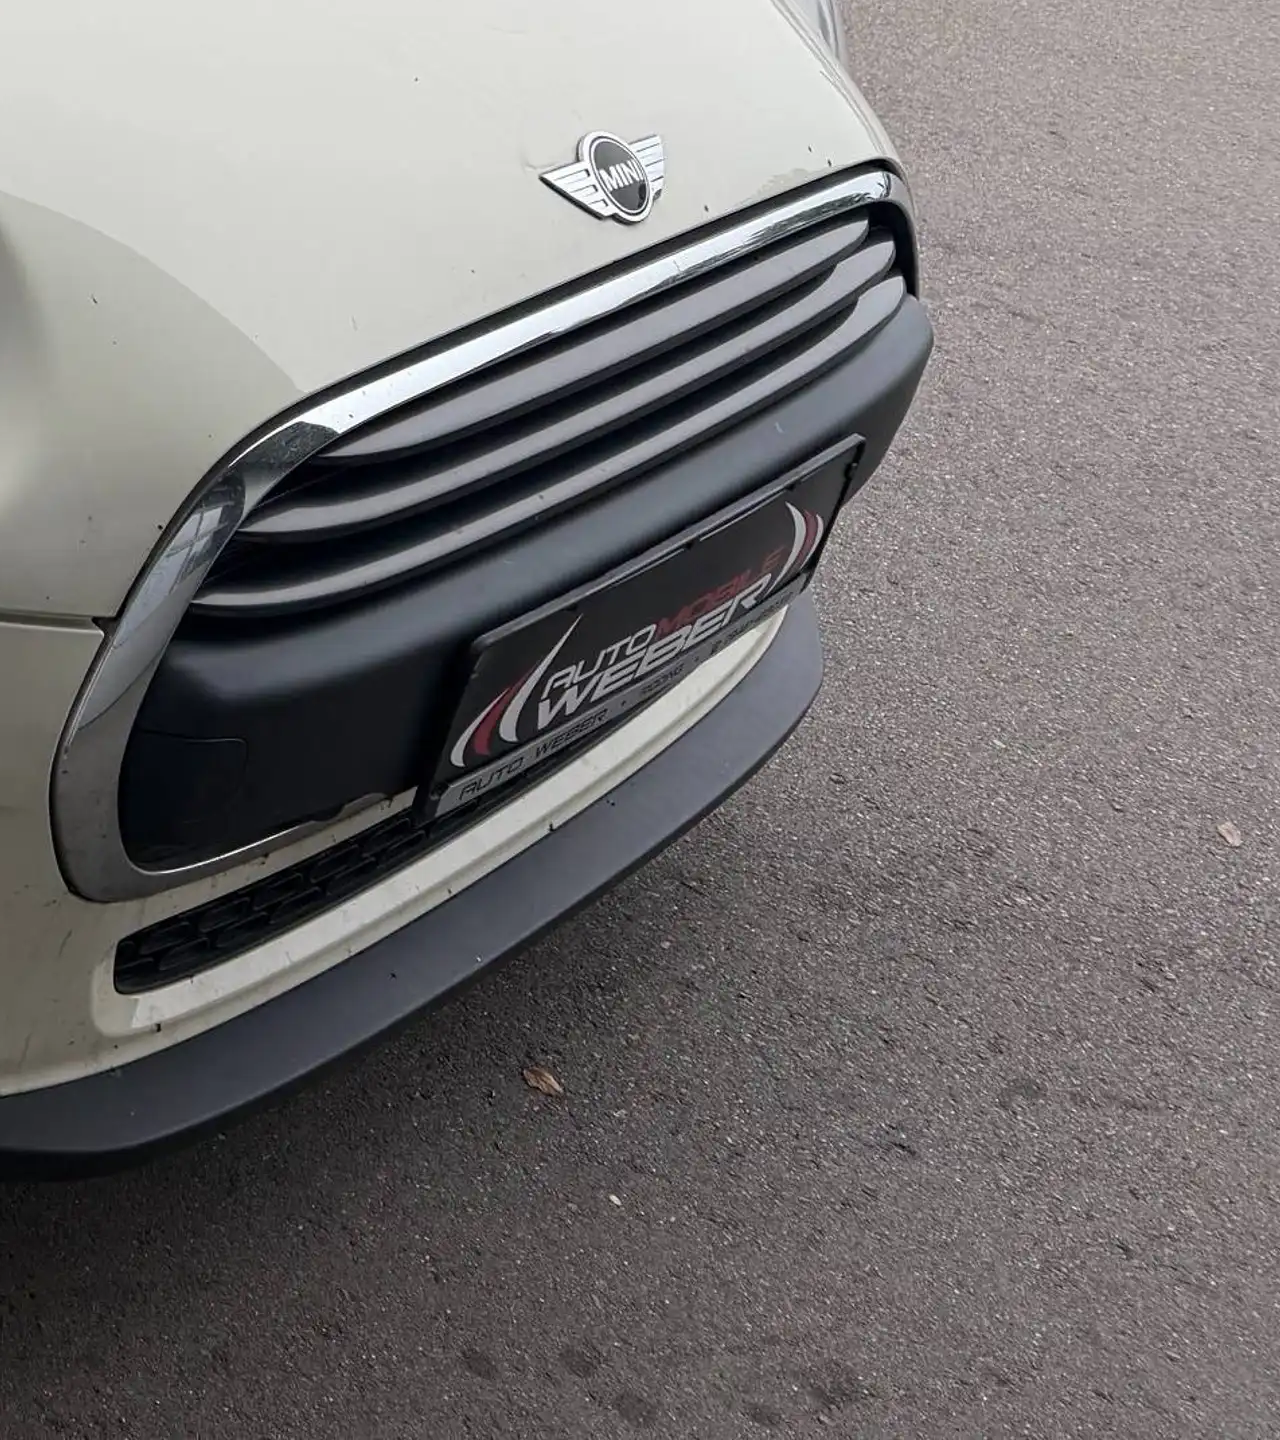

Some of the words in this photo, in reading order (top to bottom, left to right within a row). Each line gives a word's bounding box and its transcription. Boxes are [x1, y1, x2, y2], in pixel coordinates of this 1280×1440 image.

[598, 159, 645, 192] MINI
[538, 573, 772, 731] WEBER
[460, 756, 525, 801] AUTO
[536, 708, 609, 755] WEBER
